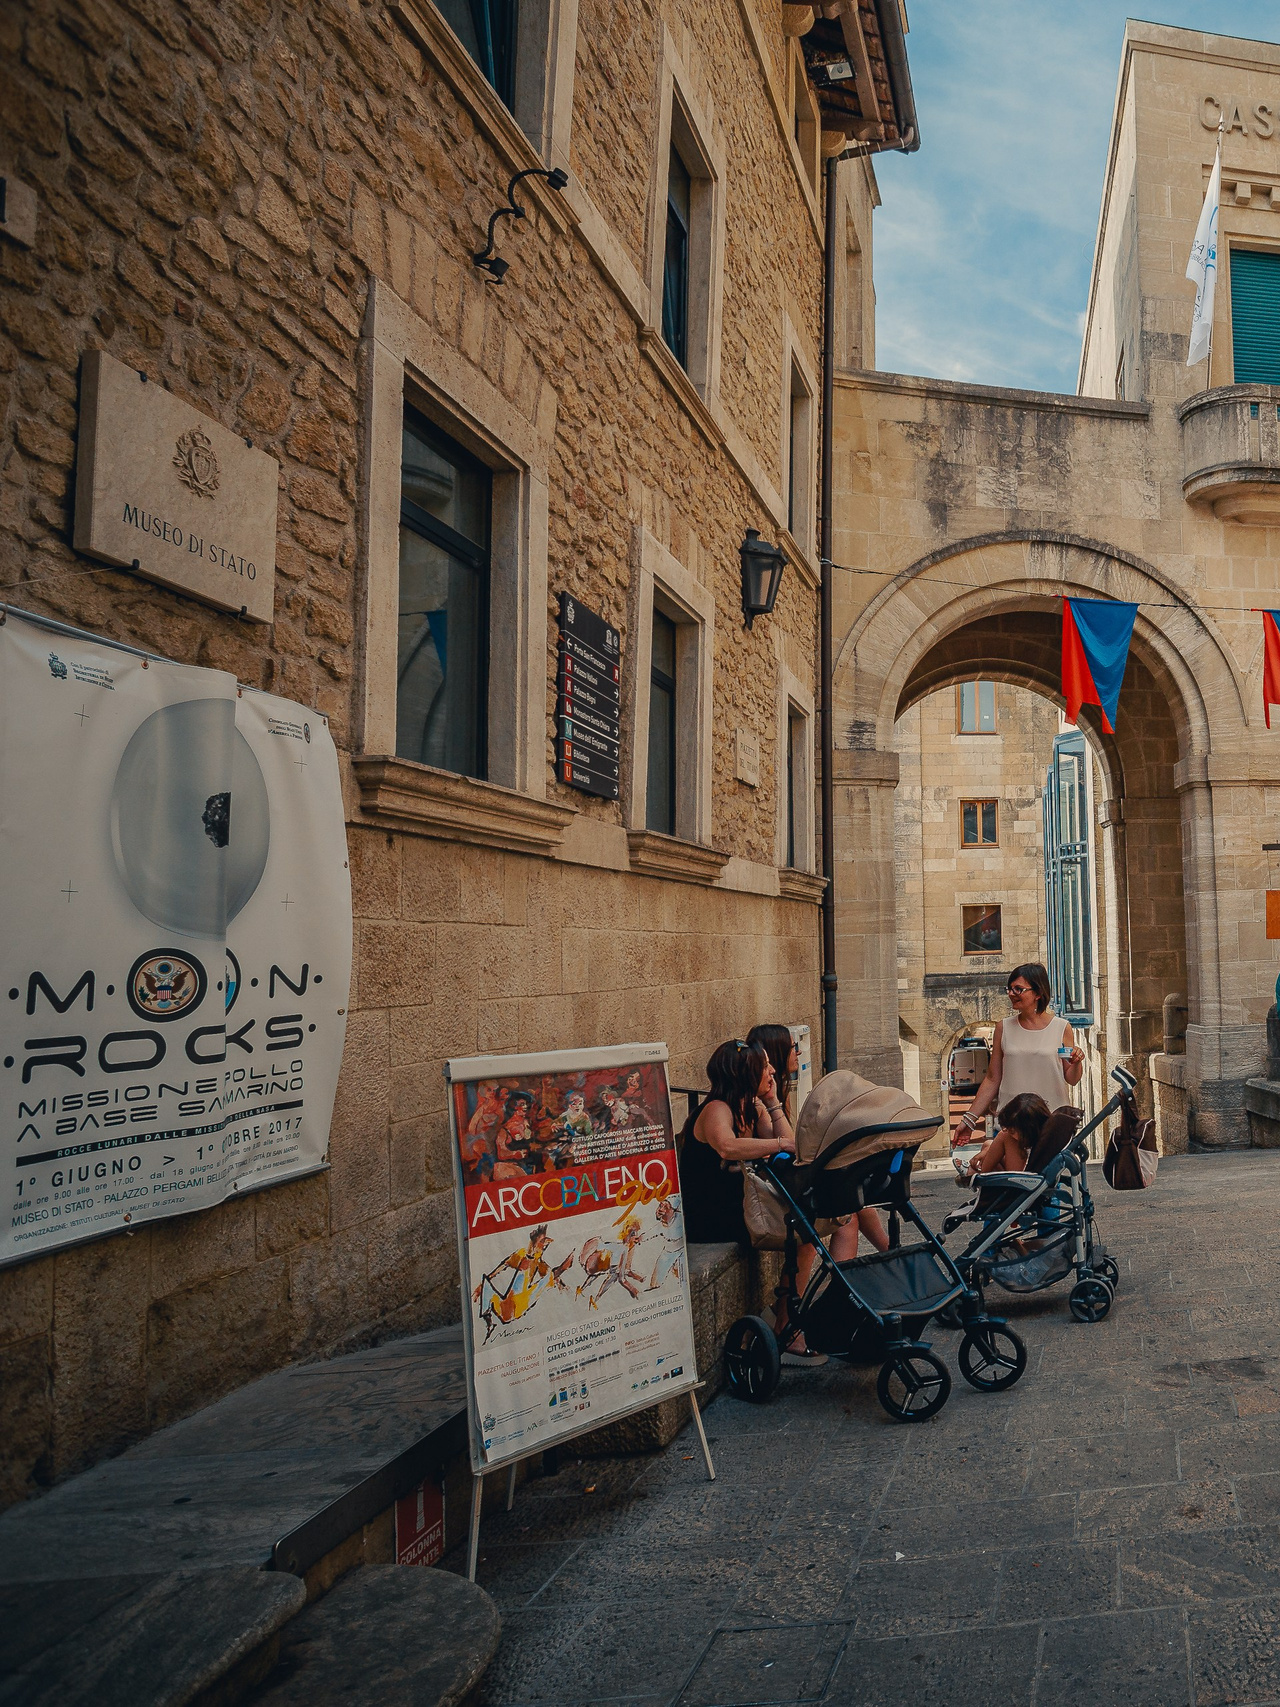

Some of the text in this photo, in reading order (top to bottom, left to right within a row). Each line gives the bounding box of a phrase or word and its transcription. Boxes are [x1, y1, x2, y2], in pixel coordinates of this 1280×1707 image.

[122, 502, 256, 580] MUSEO DI STATO
[22, 1014, 304, 1084] ROCKS
[18, 1078, 217, 1119] MISSIONE
[17, 1124, 41, 1142] A
[55, 1105, 158, 1135] BASE
[57, 1145, 92, 1158] ROCCE
[98, 1137, 138, 1150] LUNARI
[145, 1129, 188, 1142] DALLE
[51, 1156, 142, 1187] GIUGNO
[268, 1117, 303, 1135] 2017
[11, 1209, 49, 1227] MUSEO
[52, 1206, 61, 1217] DI
[65, 1198, 94, 1214] STATO
[104, 1186, 148, 1204] PALAZZO
[153, 1177, 203, 1194] PERGAMI
[77, 1186, 90, 1195] alle
[95, 1183, 107, 1191] ore
[150, 1171, 165, 1180] dal
[471, 1159, 668, 1228] ARCOBALENO
[546, 1330, 570, 1343] MUSEO
[579, 1320, 600, 1333] STATO
[603, 1310, 631, 1324] PALAZZO
[547, 1325, 616, 1353] CITTÀ DI SAN MARINO
